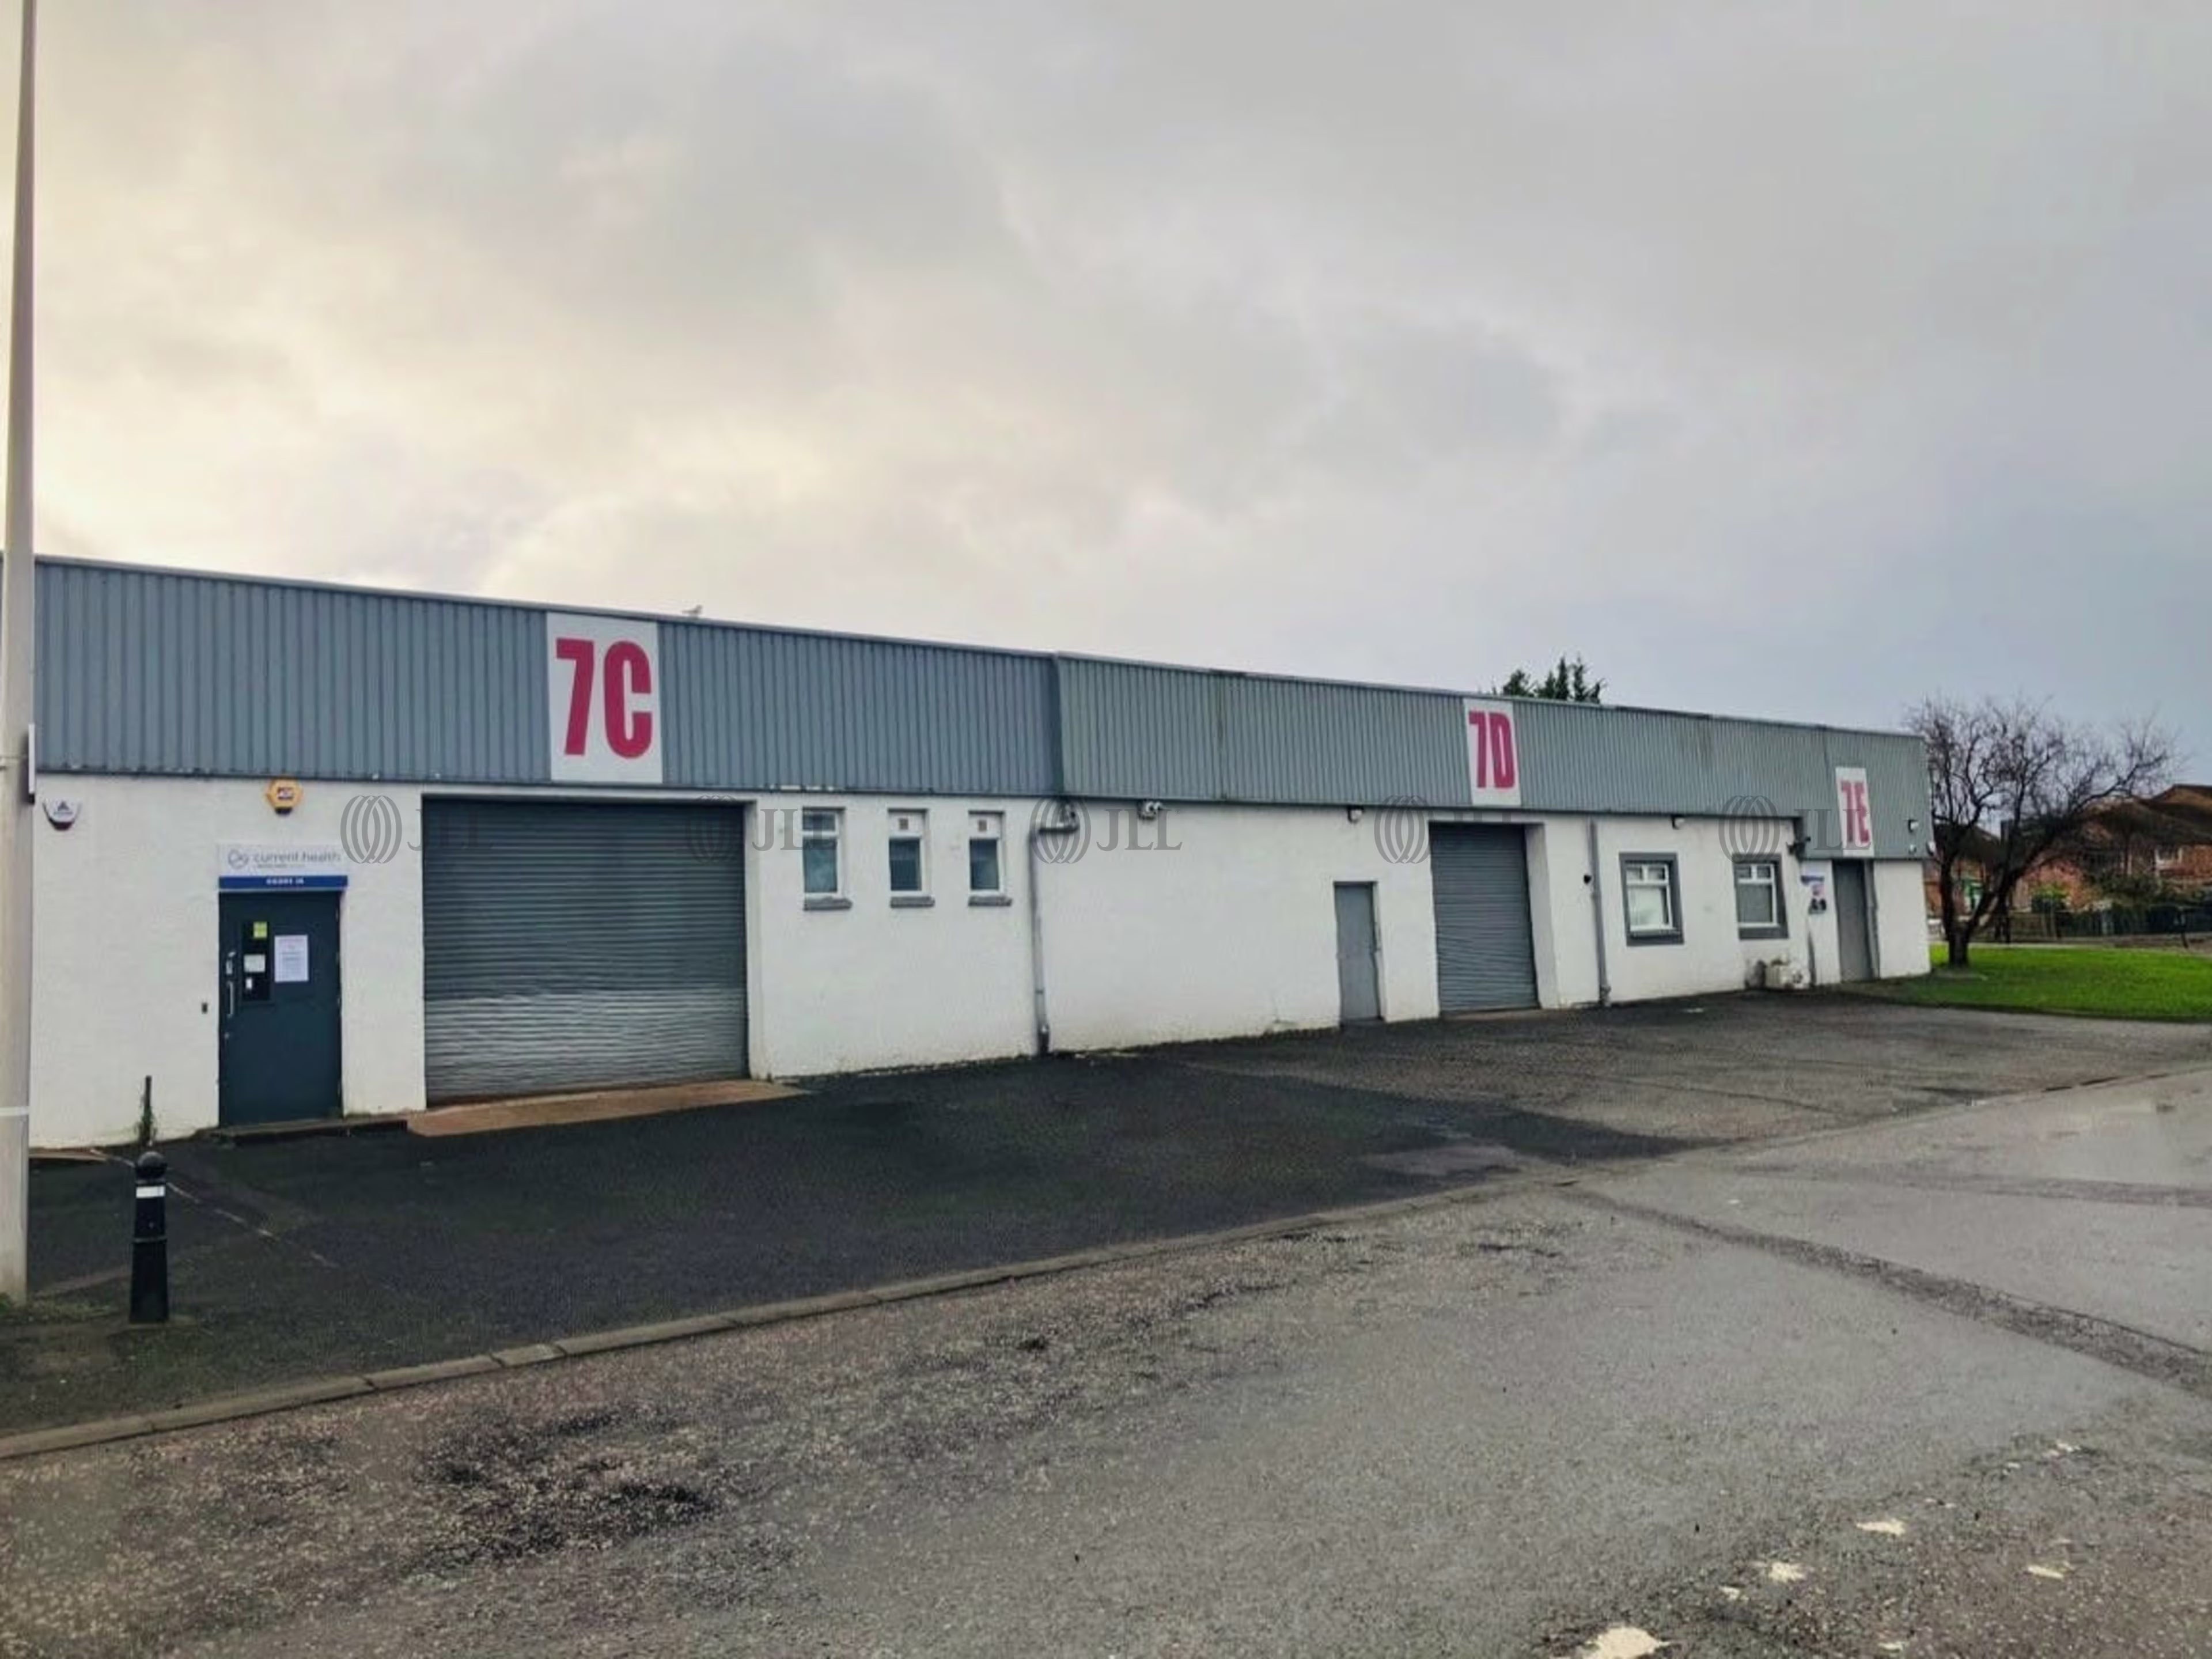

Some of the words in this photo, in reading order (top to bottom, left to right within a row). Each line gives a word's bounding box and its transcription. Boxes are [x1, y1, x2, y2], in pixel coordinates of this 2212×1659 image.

[556, 637, 653, 759] 7C
[1468, 710, 1516, 789] 7D
[1840, 780, 1870, 843] 7E
